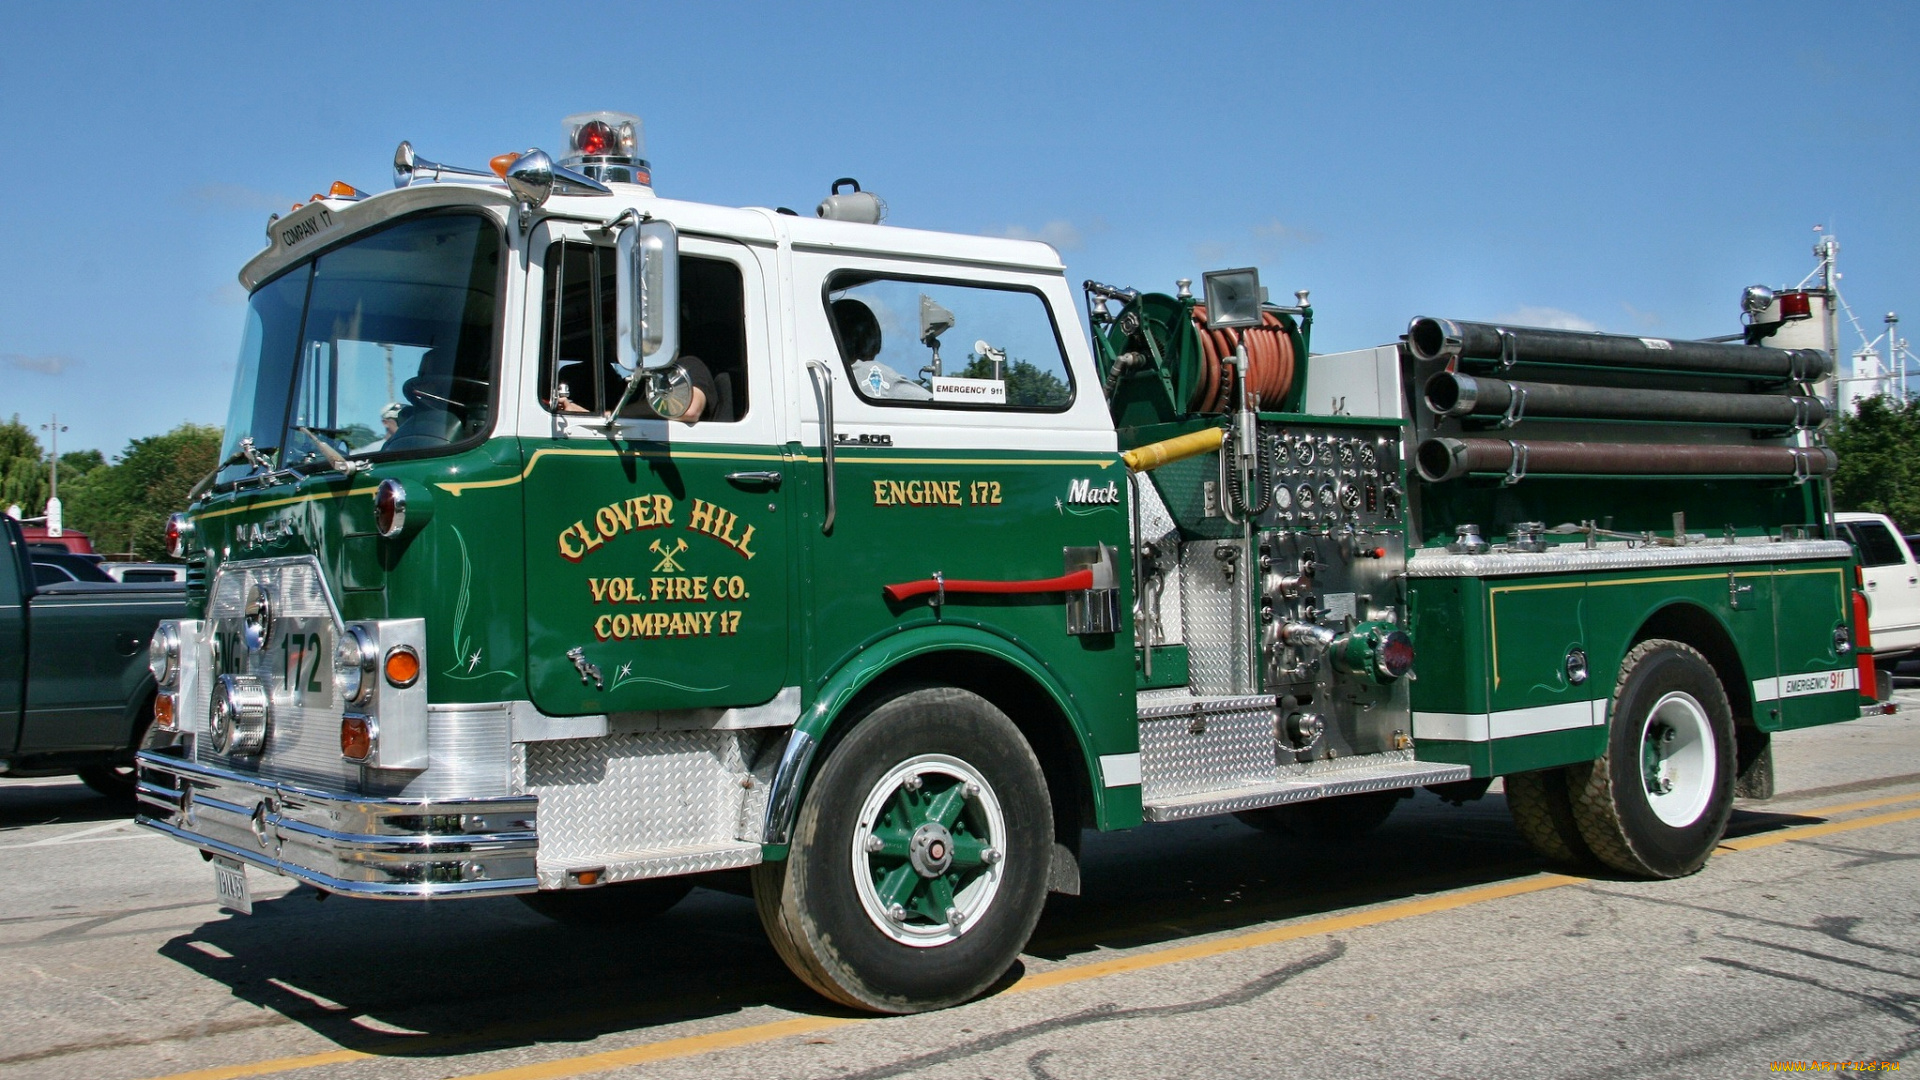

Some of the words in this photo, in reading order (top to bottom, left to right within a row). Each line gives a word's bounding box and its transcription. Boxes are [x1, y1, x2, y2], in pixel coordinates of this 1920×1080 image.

[282, 216, 319, 246] COMPANY
[320, 210, 332, 227] 17
[936, 385, 987, 395] EMERGENCY
[990, 387, 1003, 395] 911
[873, 480, 963, 507] ENGINE
[970, 480, 1003, 507] 172
[1068, 478, 1120, 506] Mack
[558, 494, 675, 563] CLOVER
[686, 498, 757, 561] HILL
[588, 577, 647, 604] VOL.
[650, 576, 709, 604] FIRE
[712, 575, 750, 600] CO.
[594, 611, 717, 642] COMPANY
[719, 610, 742, 636] 17
[281, 632, 322, 693] 172
[1786, 676, 1829, 693] EMERGENCY
[1829, 671, 1845, 690] 911
